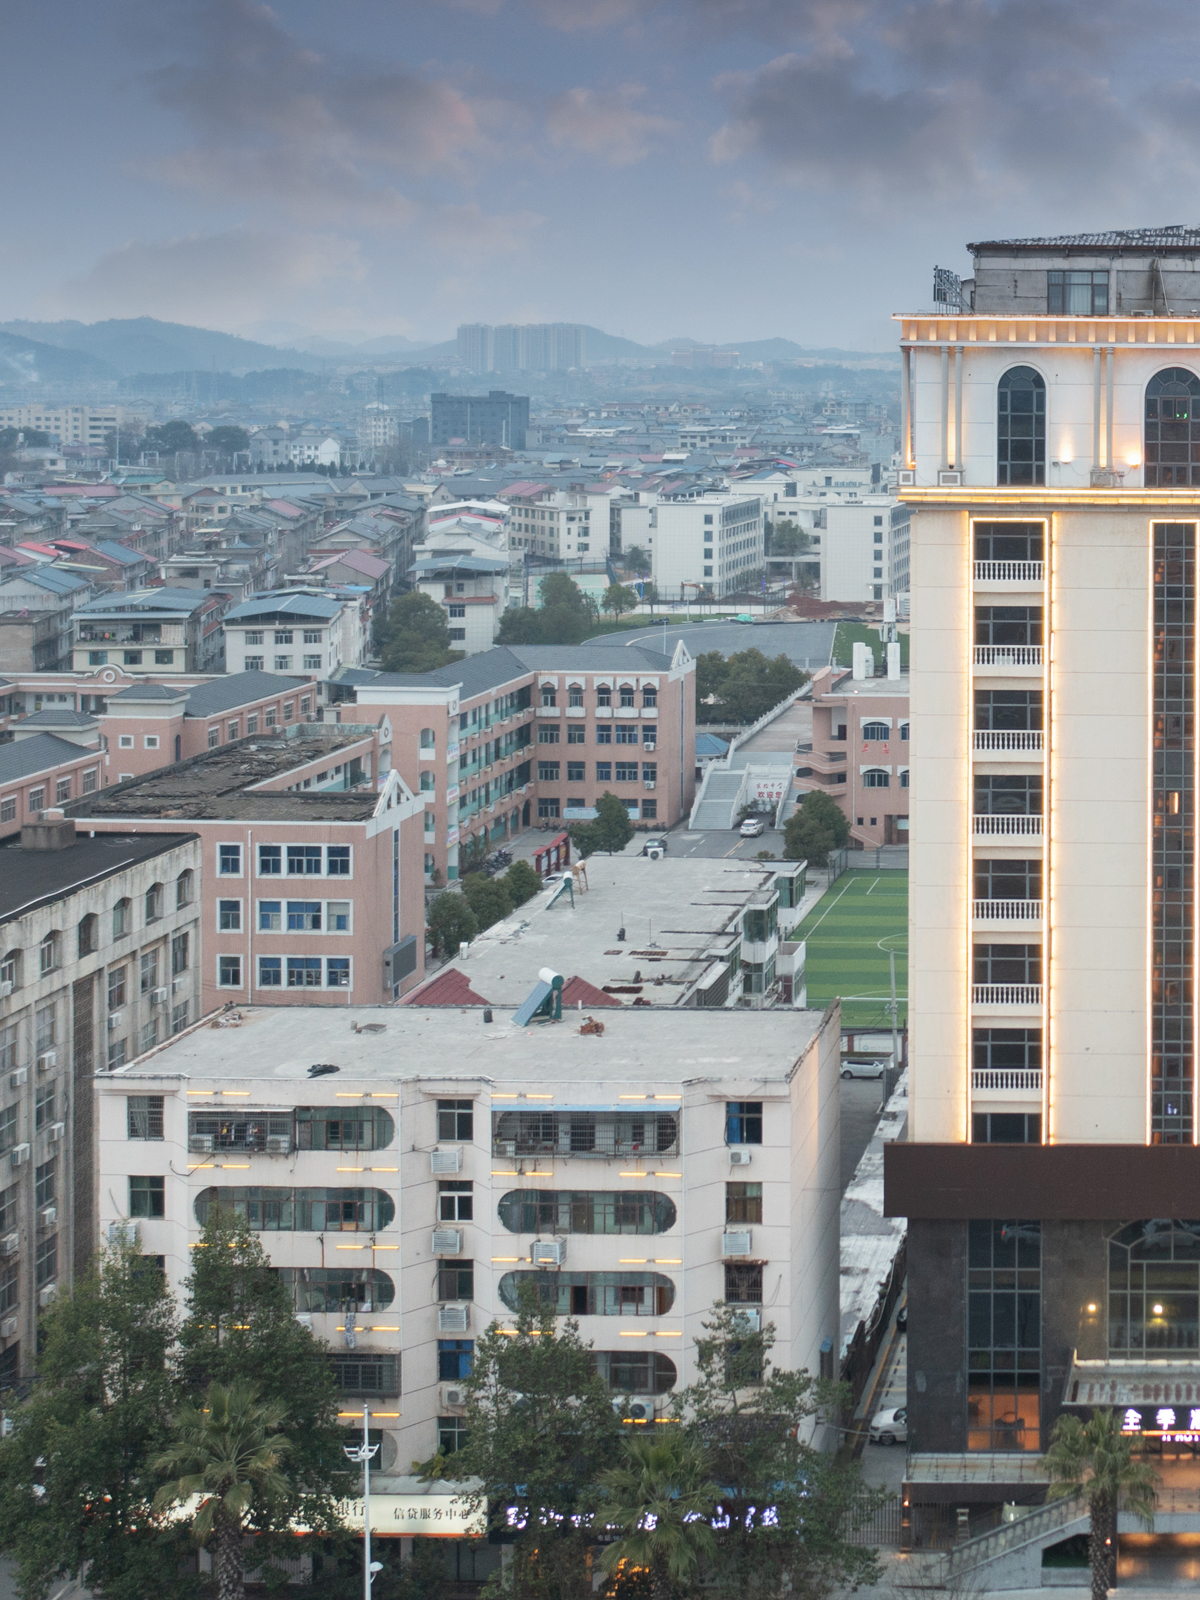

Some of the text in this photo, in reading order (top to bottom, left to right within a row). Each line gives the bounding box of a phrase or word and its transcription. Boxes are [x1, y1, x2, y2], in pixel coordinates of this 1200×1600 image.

[757, 791, 783, 799] 欢迎您
[393, 1507, 471, 1521] 信贷服务中心
